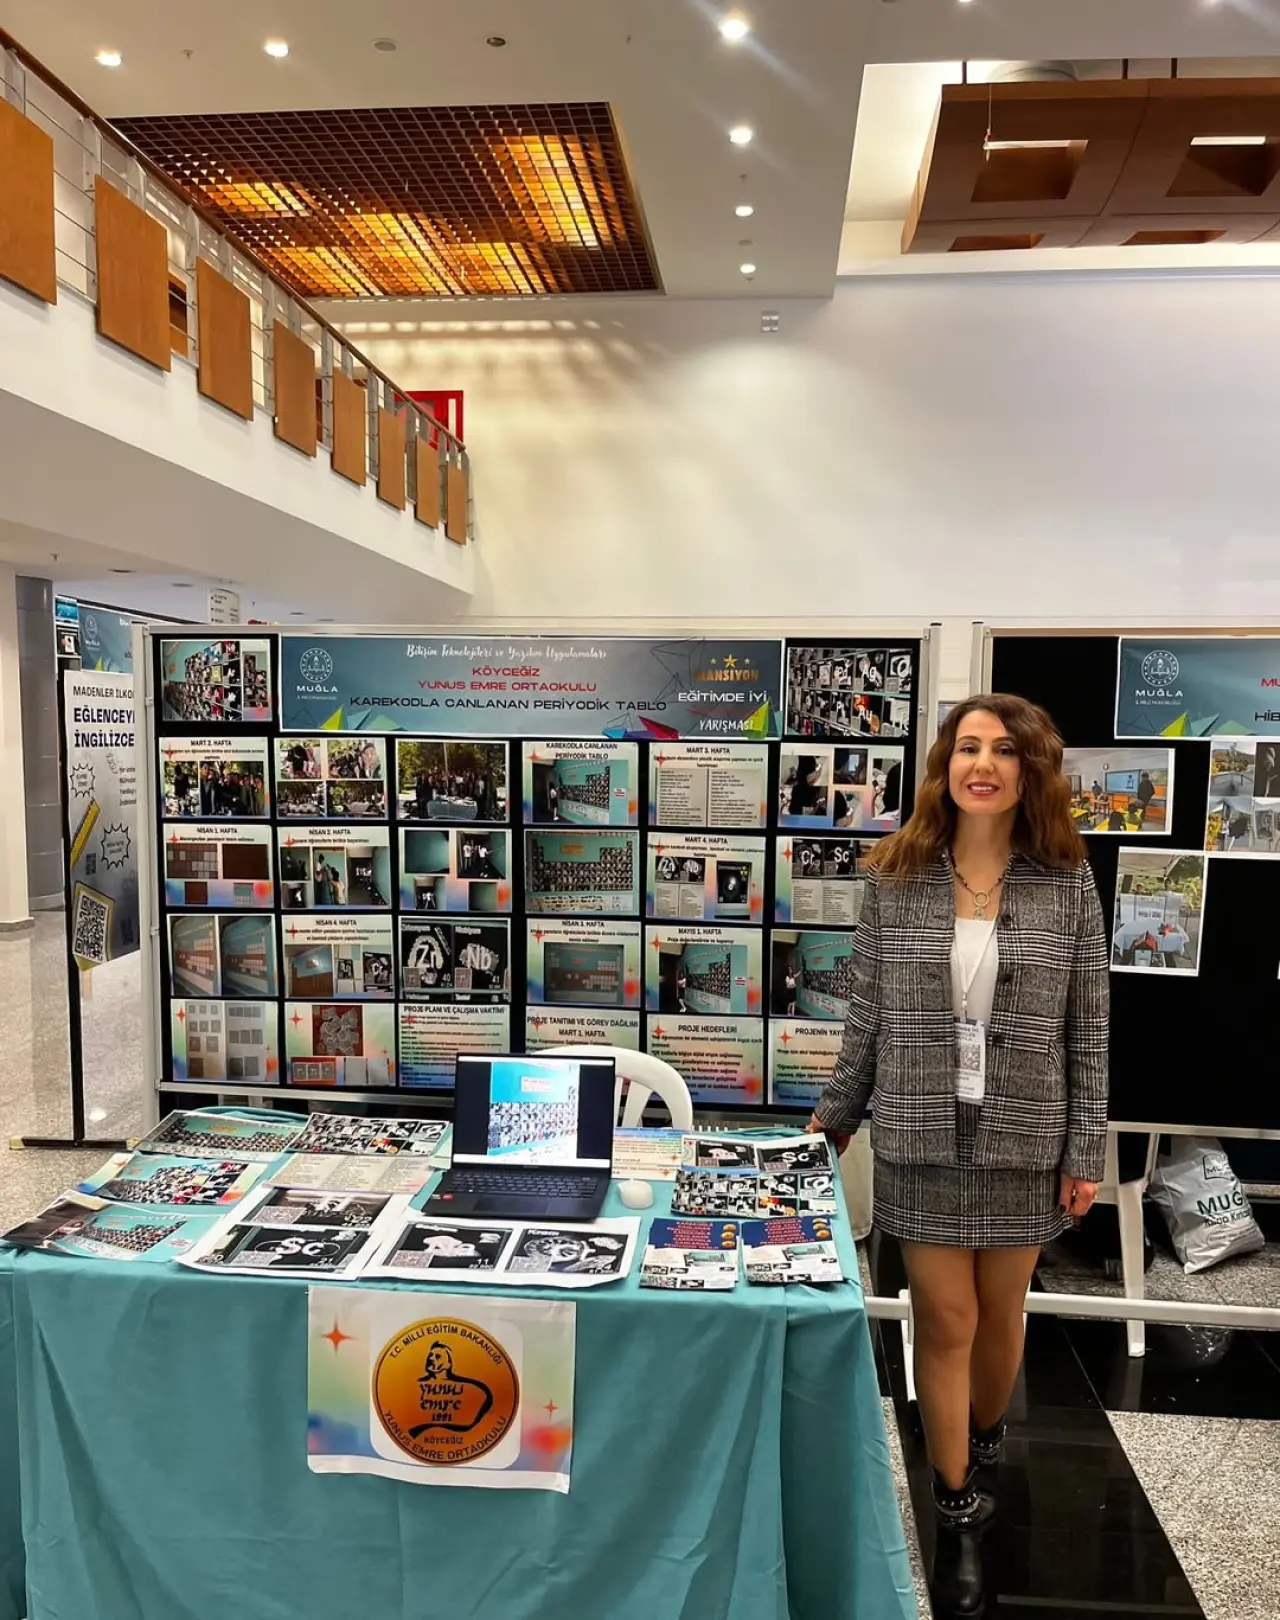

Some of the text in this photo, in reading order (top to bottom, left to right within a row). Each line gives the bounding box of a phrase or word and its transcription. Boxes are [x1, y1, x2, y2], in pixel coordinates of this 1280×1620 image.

[472, 664, 540, 677] KÖYCEĞİZ
[73, 685, 114, 698] MADENLER
[296, 683, 339, 693] MUĞLA
[418, 681, 597, 692] YUNUS EMRE ORTAOKULU
[1135, 688, 1184, 697] MUĞLA
[678, 690, 768, 702] EĞİTİMDE İYİ
[350, 697, 440, 708] KAREKODLA
[444, 698, 529, 709] CANLANAN
[533, 698, 610, 711] PERİYODİK
[616, 702, 667, 711] TABLO
[699, 718, 754, 733] YARIŞMASI
[74, 729, 134, 748] İNGİLİZCE
[546, 742, 618, 751] KAREKODLA CANLANAN
[555, 751, 609, 760] PERİYODİK TABLO
[834, 846, 850, 864] Sc
[467, 943, 492, 970] Nb
[527, 1016, 548, 1024] PROJE
[549, 1017, 576, 1025] TANITIMI
[586, 1018, 609, 1026] GÖREV
[701, 1025, 738, 1033] HEDEFLERİ
[795, 1028, 827, 1036] PROJENİN
[403, 1330, 425, 1347] MİLLİ
[426, 1325, 458, 1336] EĞİTİM
[460, 1327, 503, 1366] BAKANLIĞI
[383, 1411, 507, 1460] YUNUS EMRE ORTAOKULU
[423, 1434, 464, 1445] KÖYCEĞİZ
